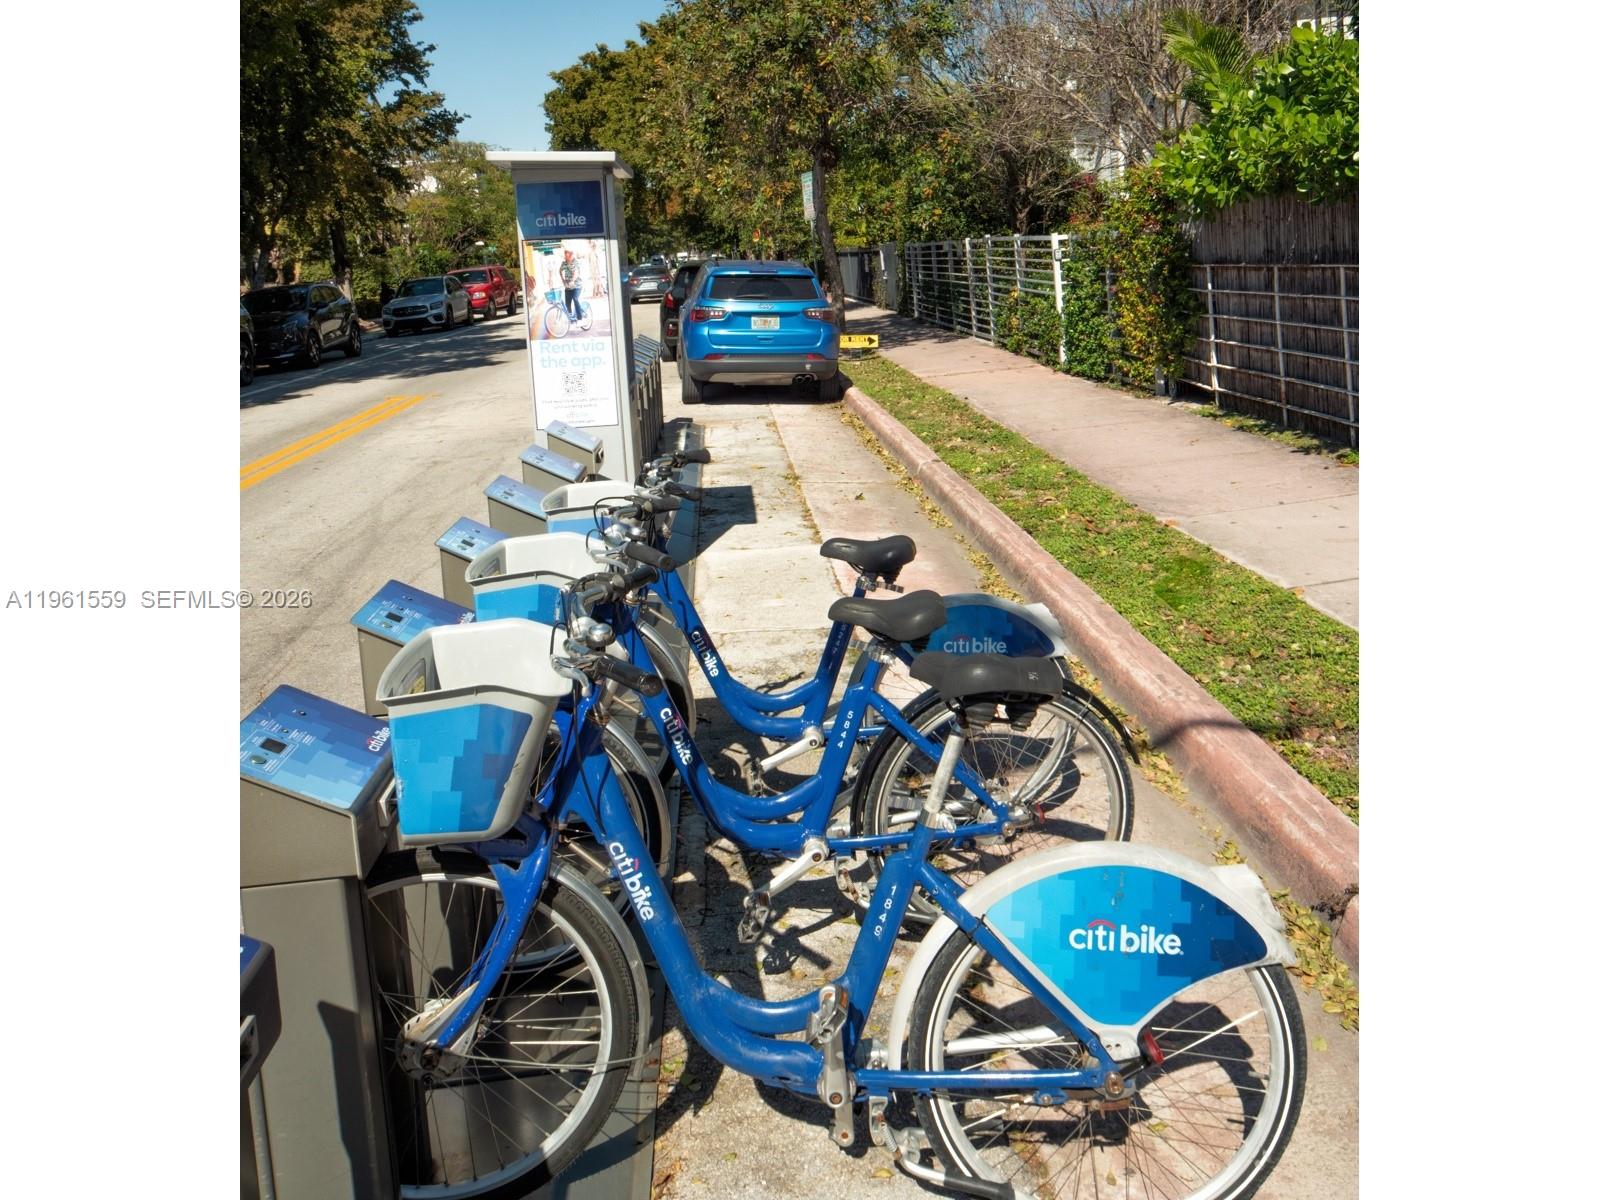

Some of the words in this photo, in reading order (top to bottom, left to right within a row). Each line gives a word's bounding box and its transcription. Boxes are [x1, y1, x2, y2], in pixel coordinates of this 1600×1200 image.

[535, 211, 557, 227] citi
[558, 213, 587, 226] bike
[540, 341, 578, 354] Rent
[582, 339, 605, 352] via
[540, 355, 567, 369] the
[571, 356, 606, 370] app.
[943, 634, 969, 653] citi
[972, 637, 1007, 653] bike
[837, 711, 854, 749] 5844
[609, 842, 639, 876] citi
[624, 872, 654, 921] bike
[873, 885, 897, 937] 1849
[1068, 919, 1116, 951] citi
[1120, 924, 1184, 956] bike
